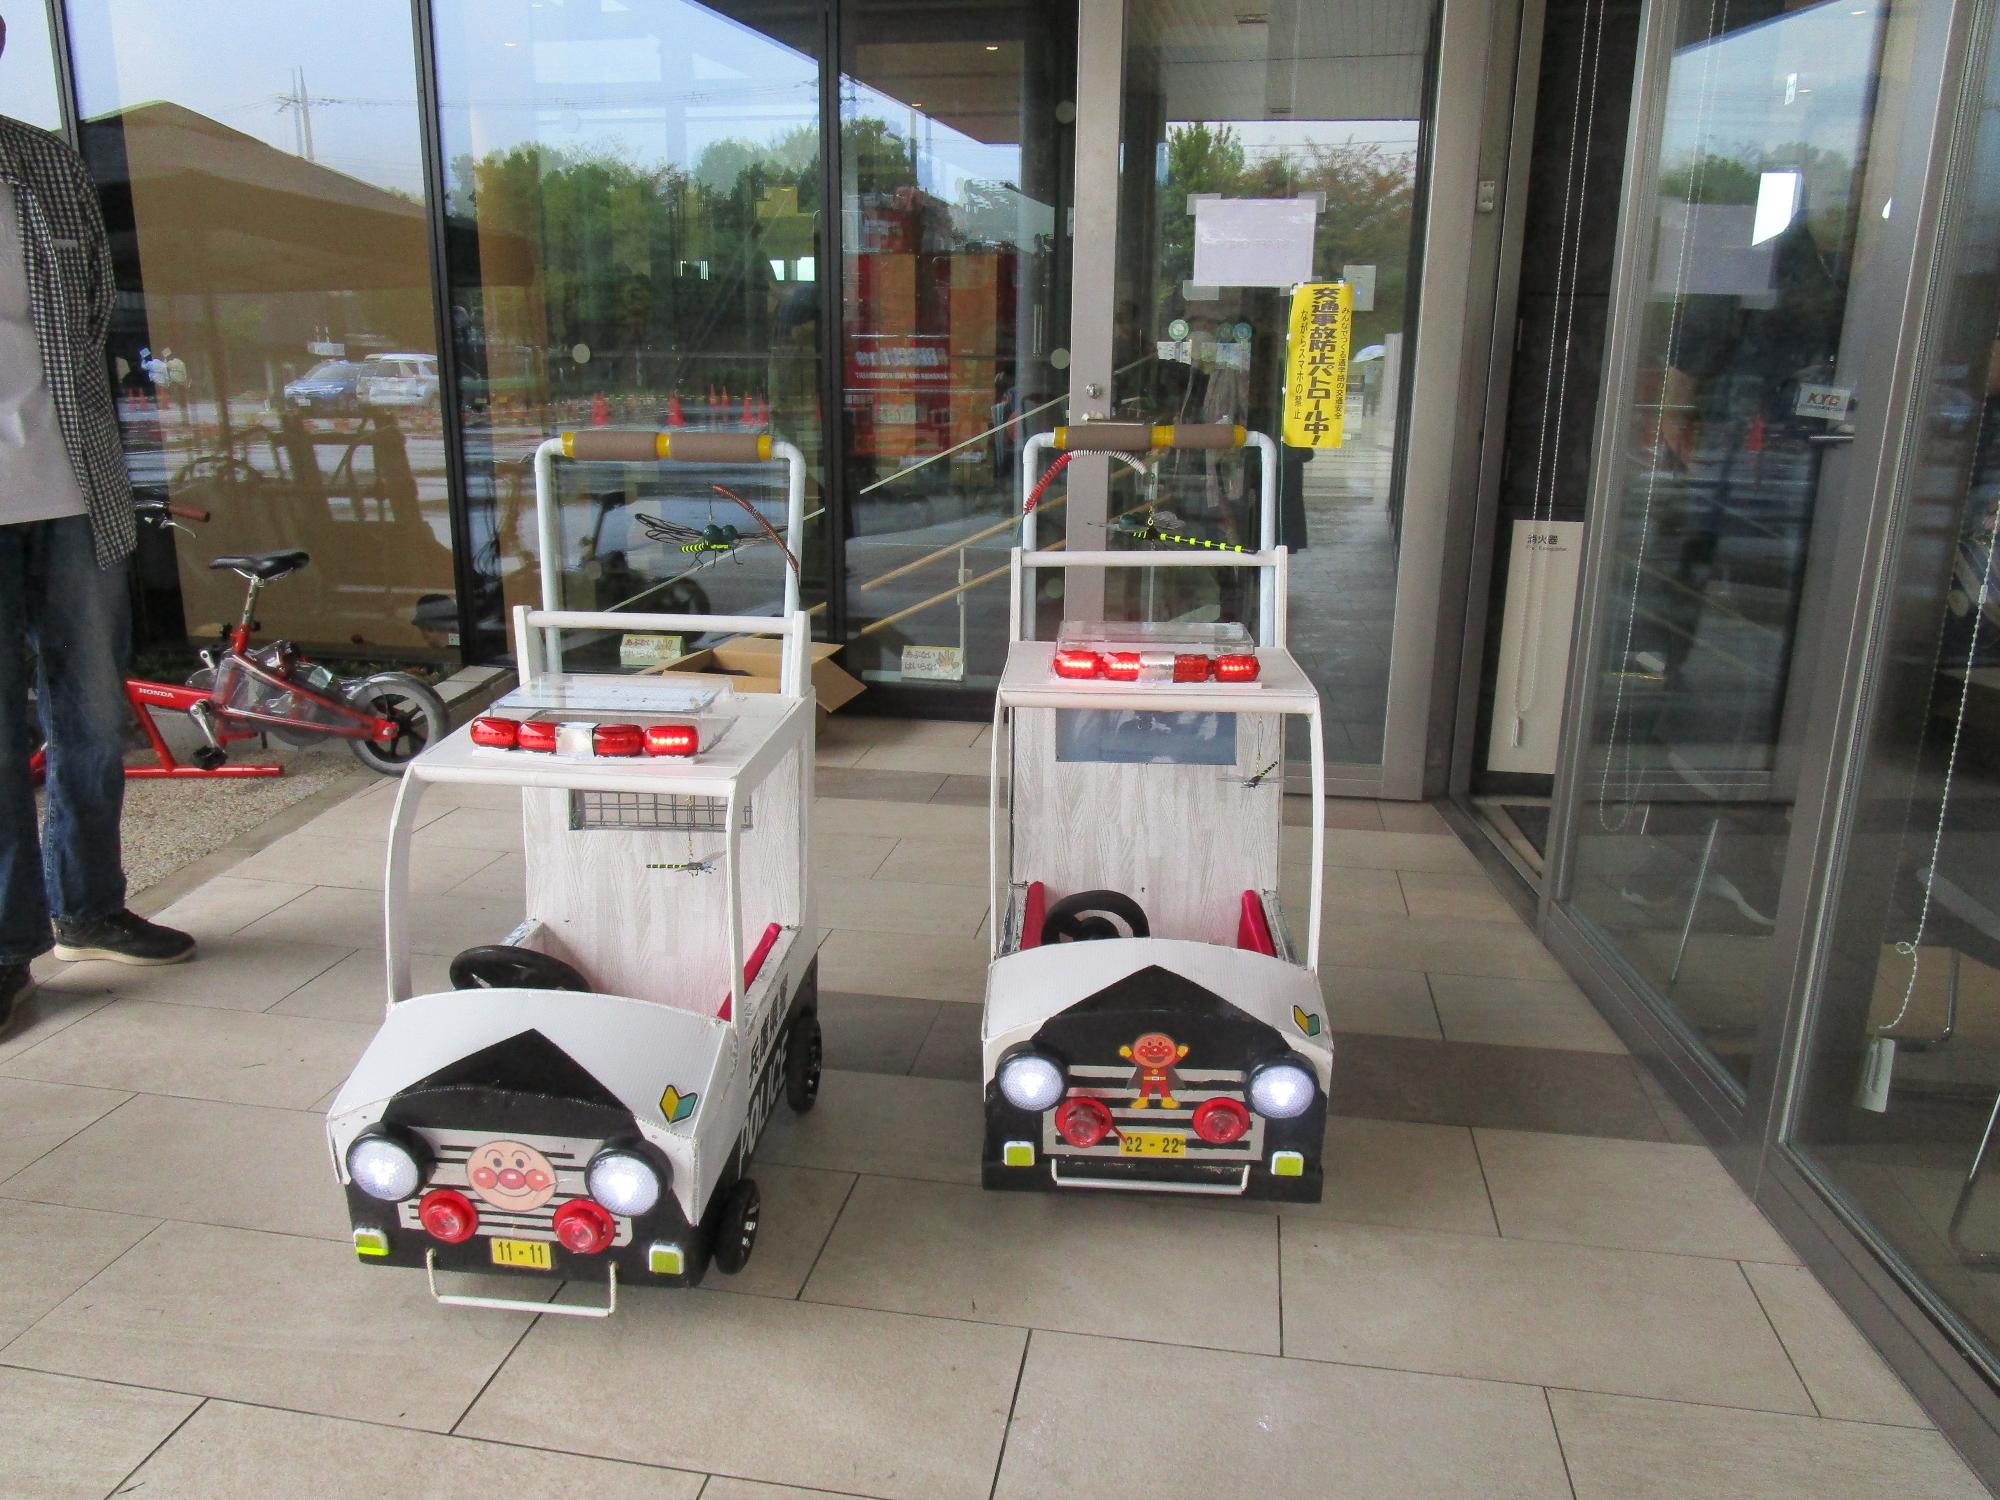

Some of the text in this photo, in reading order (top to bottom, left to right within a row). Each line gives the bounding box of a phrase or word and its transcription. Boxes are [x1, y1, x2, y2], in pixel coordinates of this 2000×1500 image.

[1303, 287, 1341, 446] 交通事故防止パトロール中!
[138, 687, 174, 699] HONDA
[737, 1029, 789, 1178] POLICE
